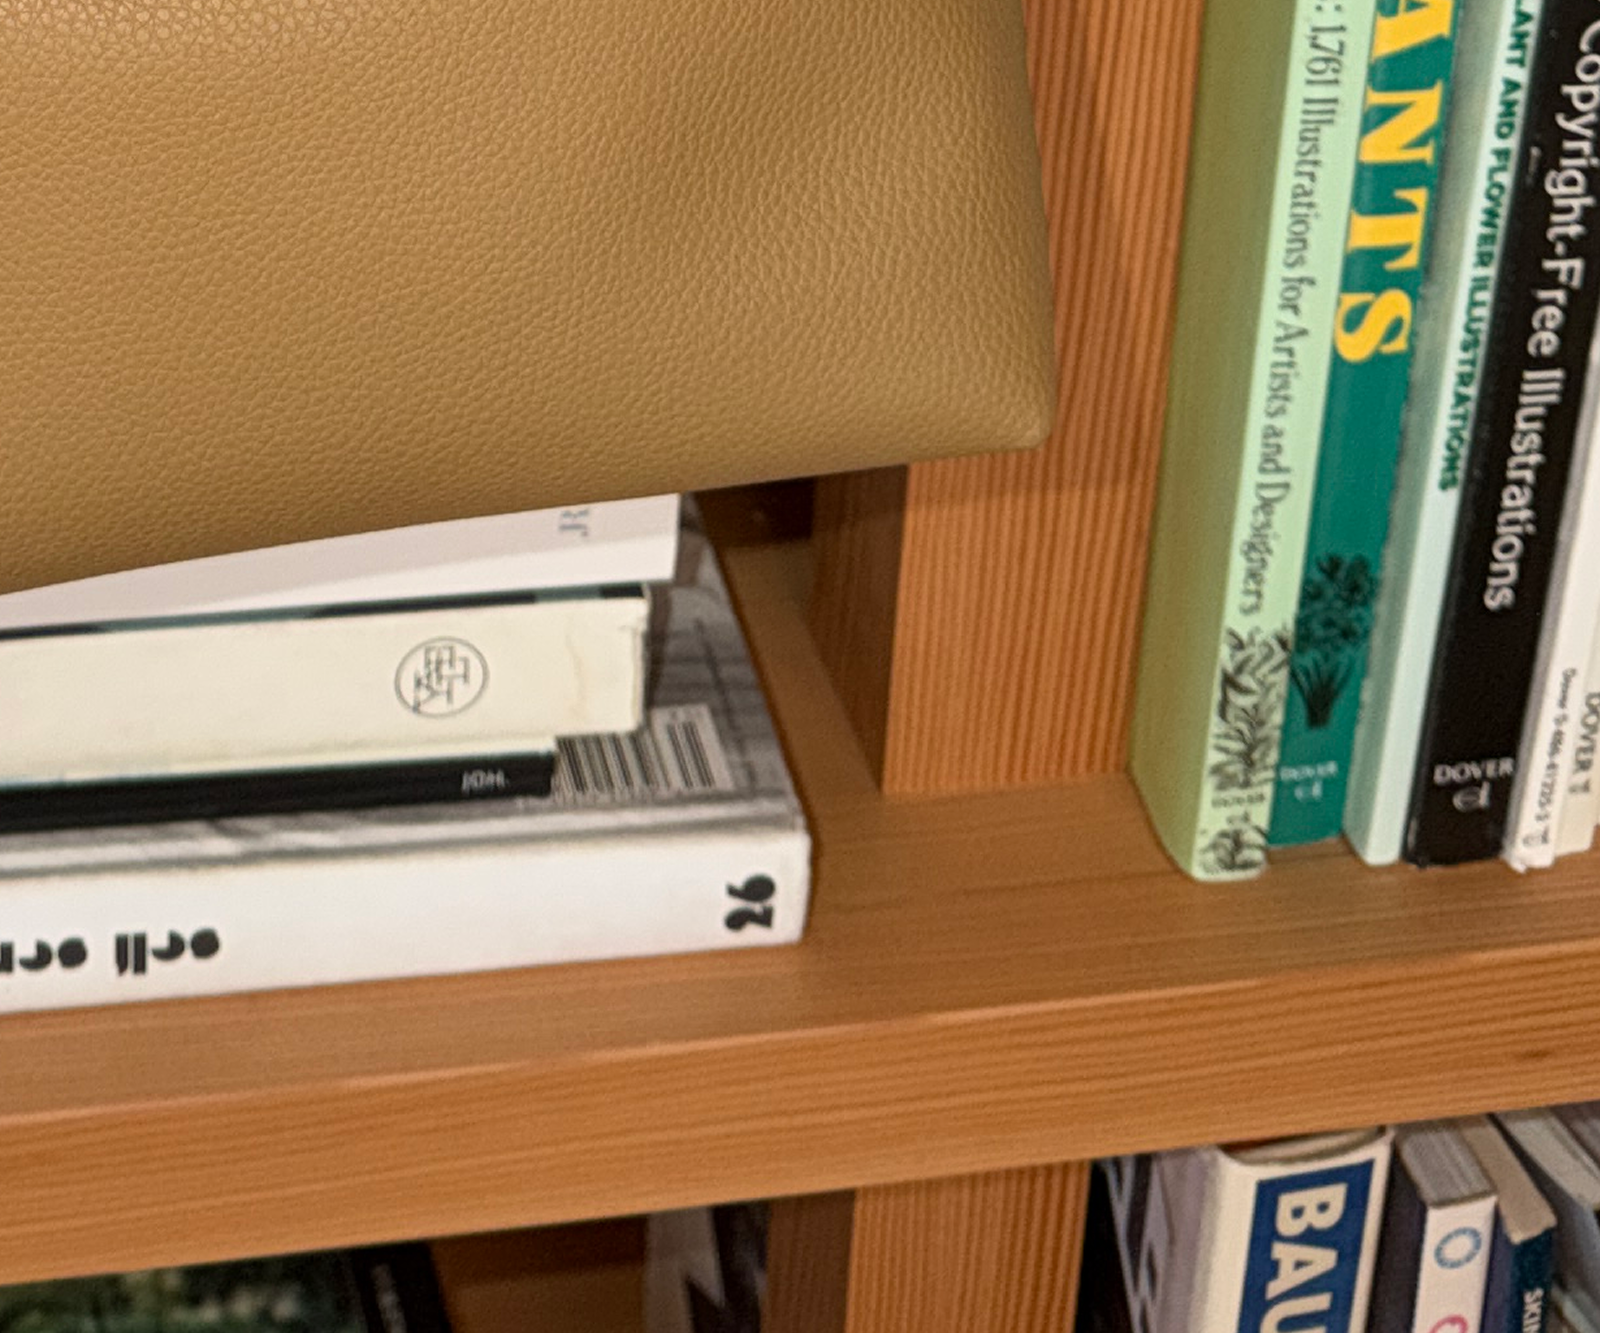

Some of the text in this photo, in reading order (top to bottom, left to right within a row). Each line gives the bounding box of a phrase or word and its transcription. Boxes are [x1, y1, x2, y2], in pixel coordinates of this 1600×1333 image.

[1493, 77, 1521, 140] AND
[1280, 96, 1340, 269] Illustrations
[1472, 147, 1512, 270] FLOWER
[1280, 275, 1316, 309] for
[1268, 314, 1308, 421] Artists
[1439, 275, 1493, 492] ILLUSTRATIONS
[1257, 426, 1289, 475] and
[1483, 369, 1565, 612] Illustrations
[1237, 481, 1291, 616] Designers
[1433, 757, 1516, 786] DOVER
